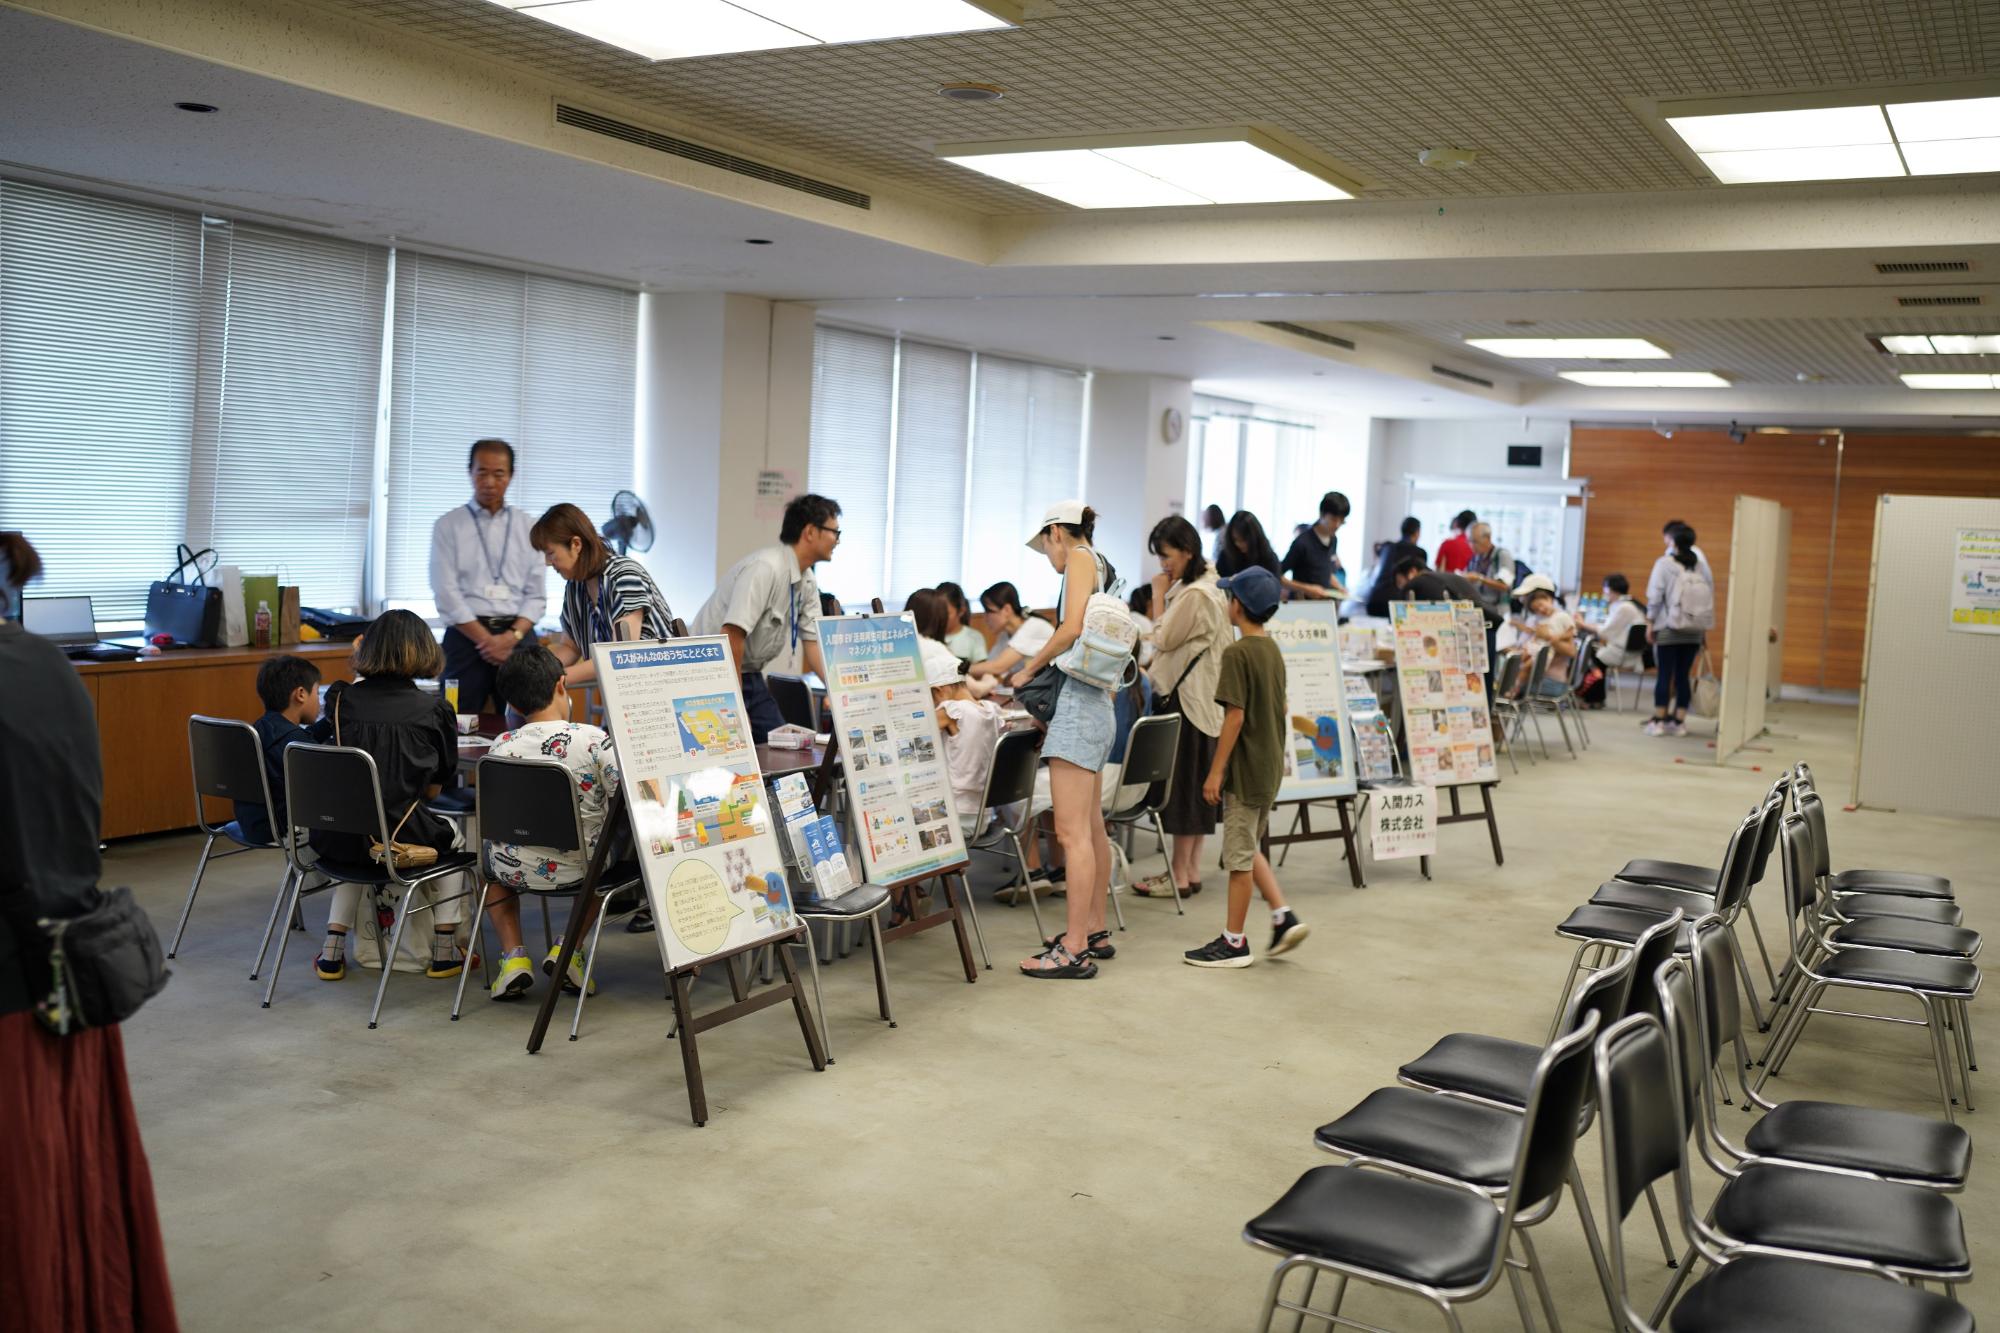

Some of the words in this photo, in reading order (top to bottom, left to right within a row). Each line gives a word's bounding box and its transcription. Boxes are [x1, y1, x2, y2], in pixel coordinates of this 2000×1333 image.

[615, 647, 720, 665] ガスがみんなのおうちにとどくまで
[1381, 794, 1424, 810] 入間ガス
[1380, 815, 1424, 832] 株式会社
